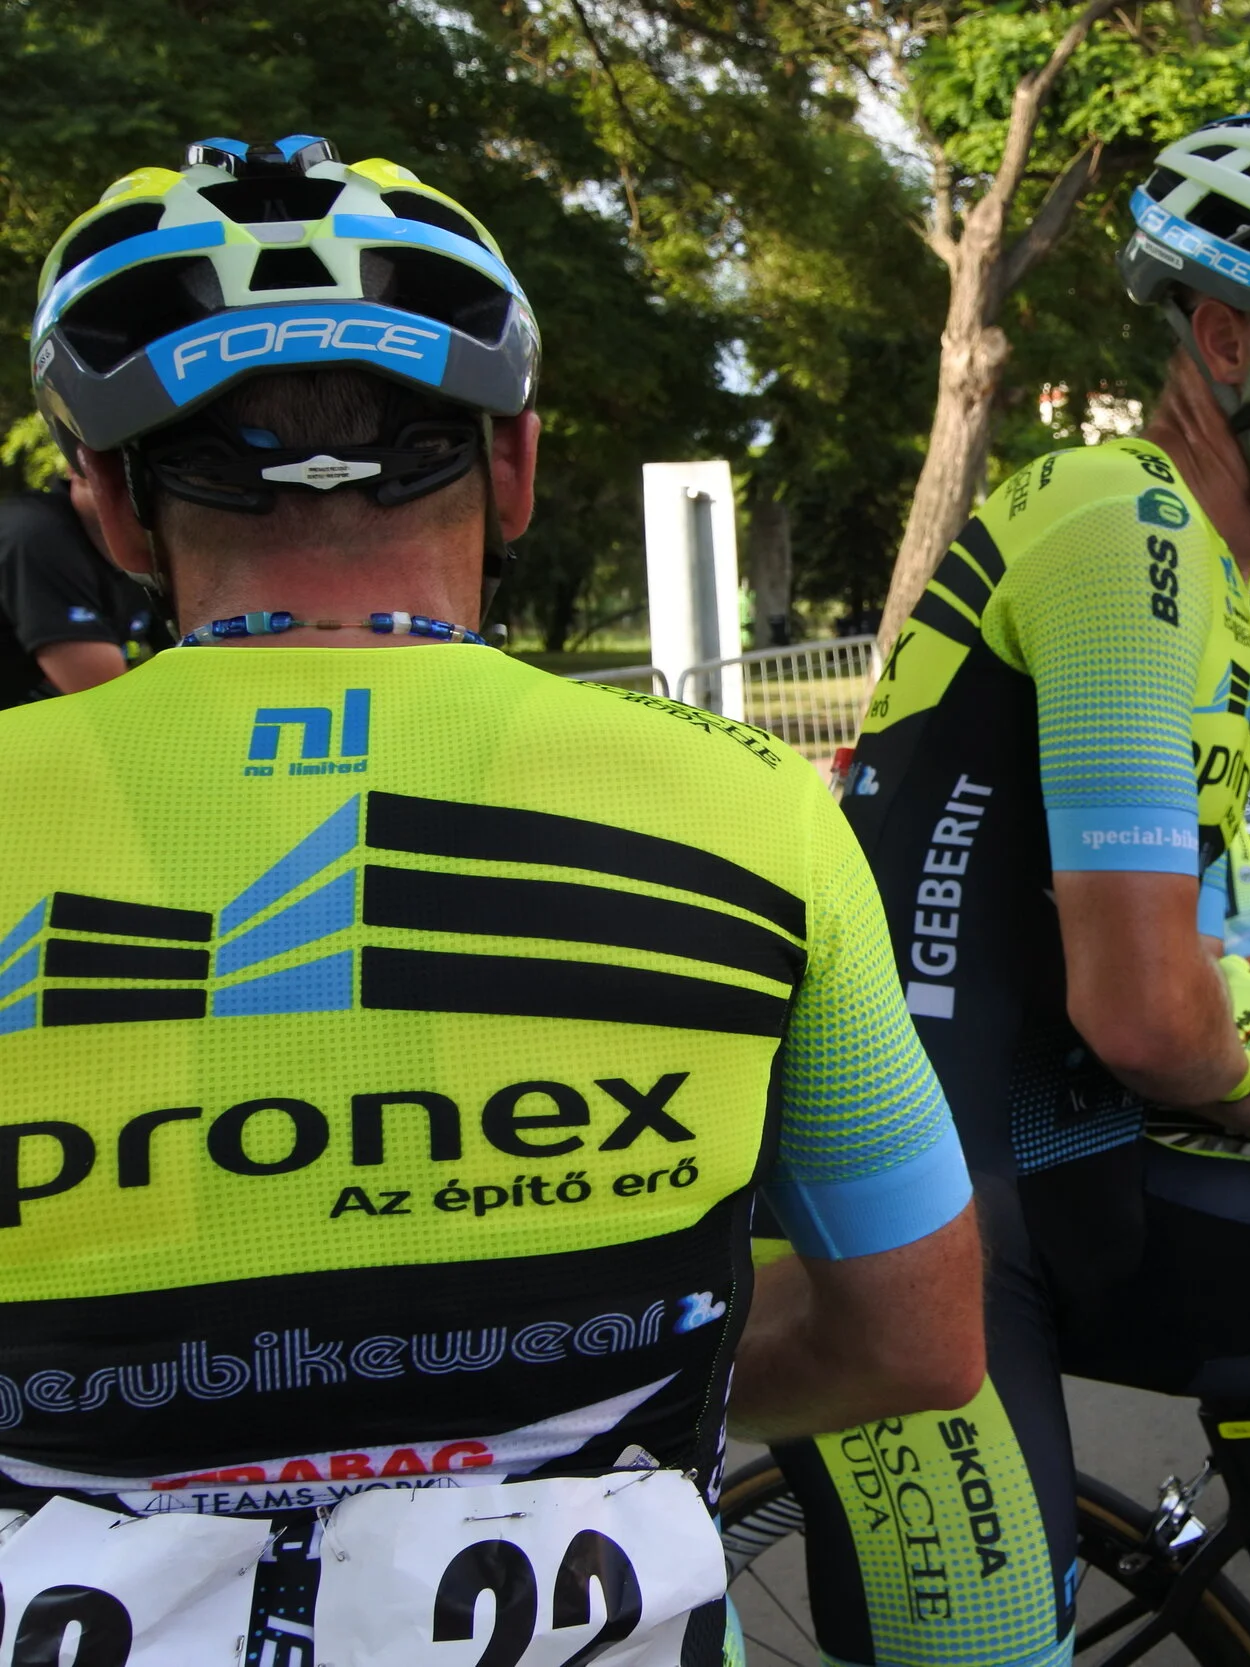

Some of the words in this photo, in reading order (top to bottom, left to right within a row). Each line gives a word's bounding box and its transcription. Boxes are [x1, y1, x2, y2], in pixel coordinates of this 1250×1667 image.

[173, 317, 440, 381] FORCE
[1147, 534, 1179, 628] BSS
[243, 765, 275, 777] no
[288, 758, 369, 776] limited
[248, 687, 371, 761] nl
[911, 773, 994, 977] GEBERIT
[0, 1071, 696, 1228] pronex
[329, 1186, 412, 1219] Az
[434, 1170, 592, 1217] építő
[613, 1156, 699, 1197] erő
[152, 1440, 494, 1491] RABAG
[192, 1486, 315, 1515] TEAMS
[840, 1432, 891, 1534] UDA
[938, 1416, 1007, 1580] ŠKODA
[874, 1416, 953, 1623] RSCHE
[432, 1529, 643, 1667] 22
